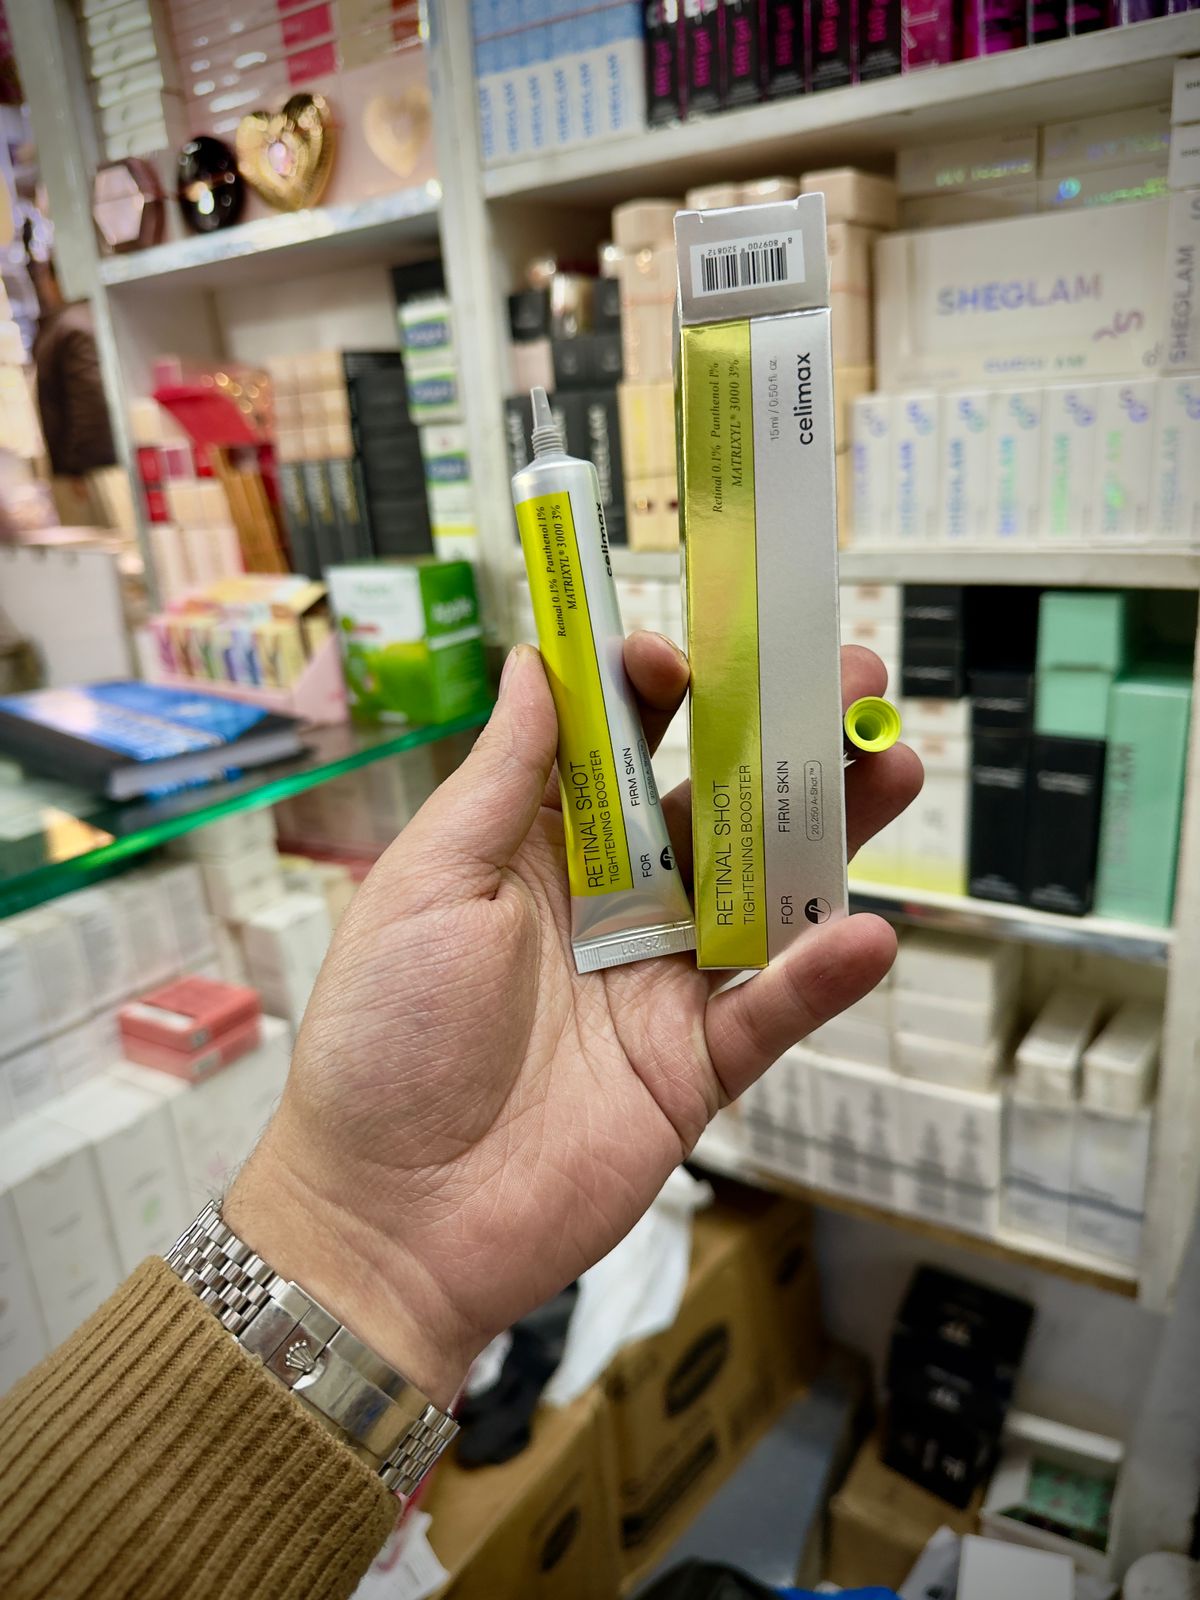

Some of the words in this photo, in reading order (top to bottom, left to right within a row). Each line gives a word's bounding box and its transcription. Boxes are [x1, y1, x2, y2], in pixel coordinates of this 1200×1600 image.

[748, 239, 778, 250] 809700
[937, 271, 1103, 316] SHEGLAM
[1169, 244, 1195, 363] SHEGLAM
[709, 362, 719, 378] 1%
[728, 359, 740, 378] 3%
[709, 380, 722, 438] Panthenol
[729, 381, 742, 411] 3000
[793, 352, 814, 445] celimax
[770, 417, 779, 442] 15ml
[711, 445, 722, 474] 0.1%
[712, 475, 723, 513] Retinal
[536, 506, 547, 521] 1%
[550, 504, 562, 520] 3%
[539, 523, 556, 573] Panthenol
[553, 523, 567, 548] 3000
[596, 502, 613, 577] celimax
[549, 578, 562, 603] 0.1%
[554, 605, 567, 637] Retinal
[622, 747, 636, 775] SKIN
[776, 760, 790, 795] SKIN
[569, 761, 593, 812] SHOT
[589, 749, 612, 810] BOOSTER
[628, 777, 641, 807] FIRM
[713, 780, 731, 836] SHOT
[739, 765, 753, 833] BOOSTER
[778, 798, 790, 833] FIRM
[811, 806, 820, 835] 20,250
[579, 814, 605, 889] RETINAL
[599, 810, 621, 885] TIGHTENING
[639, 853, 652, 878] FOR
[741, 836, 755, 925] TIGHTENING
[715, 842, 733, 926] RETINAL
[781, 895, 794, 925] FOR
